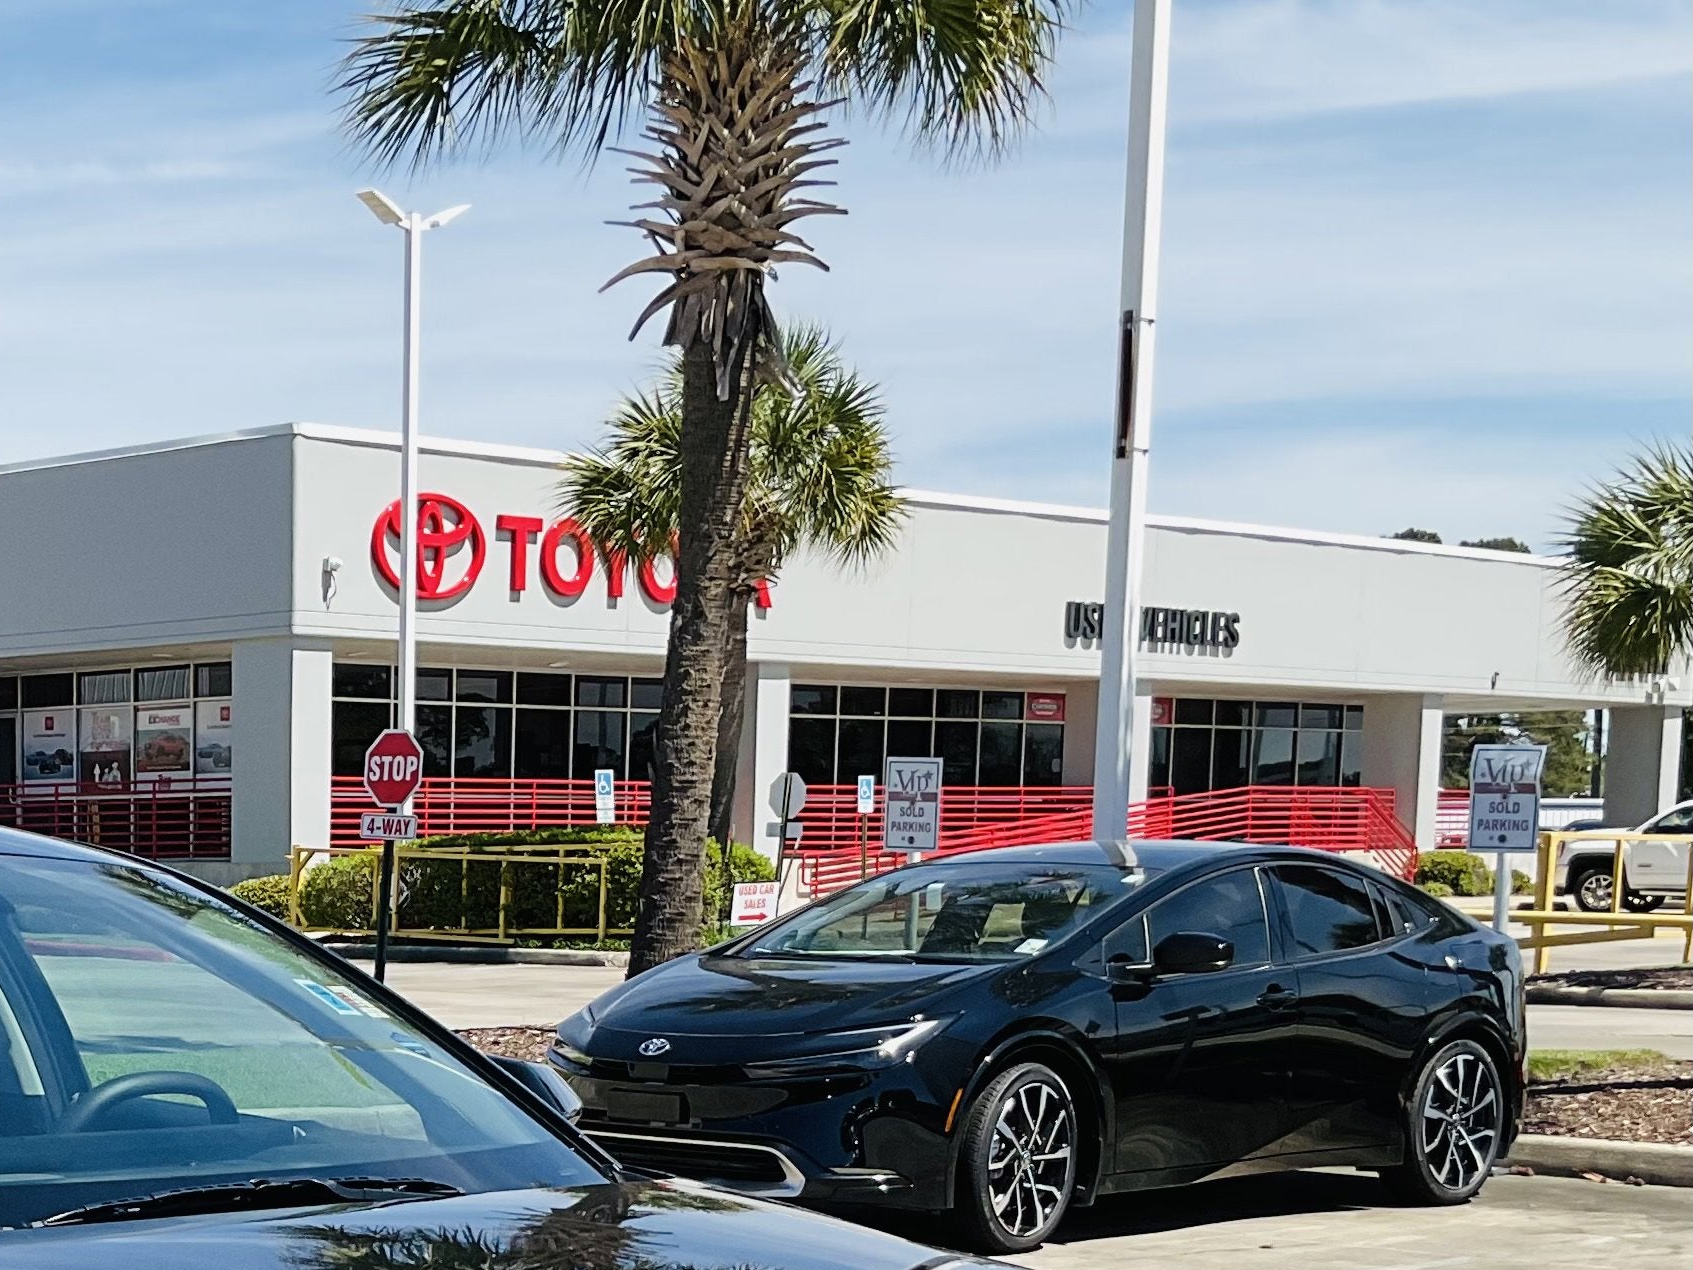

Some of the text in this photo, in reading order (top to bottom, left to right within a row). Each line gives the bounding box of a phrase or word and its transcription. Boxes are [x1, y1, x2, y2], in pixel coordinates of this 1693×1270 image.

[1065, 602, 1105, 640] US
[369, 755, 418, 781] STOP
[899, 806, 924, 818] SOLD
[1488, 801, 1520, 814] SOLD
[367, 818, 411, 836] 4-WAY
[890, 821, 932, 833] PARKING
[1477, 819, 1529, 832] PARKING
[739, 884, 775, 896] USED CAR
[743, 899, 766, 909] SALES
